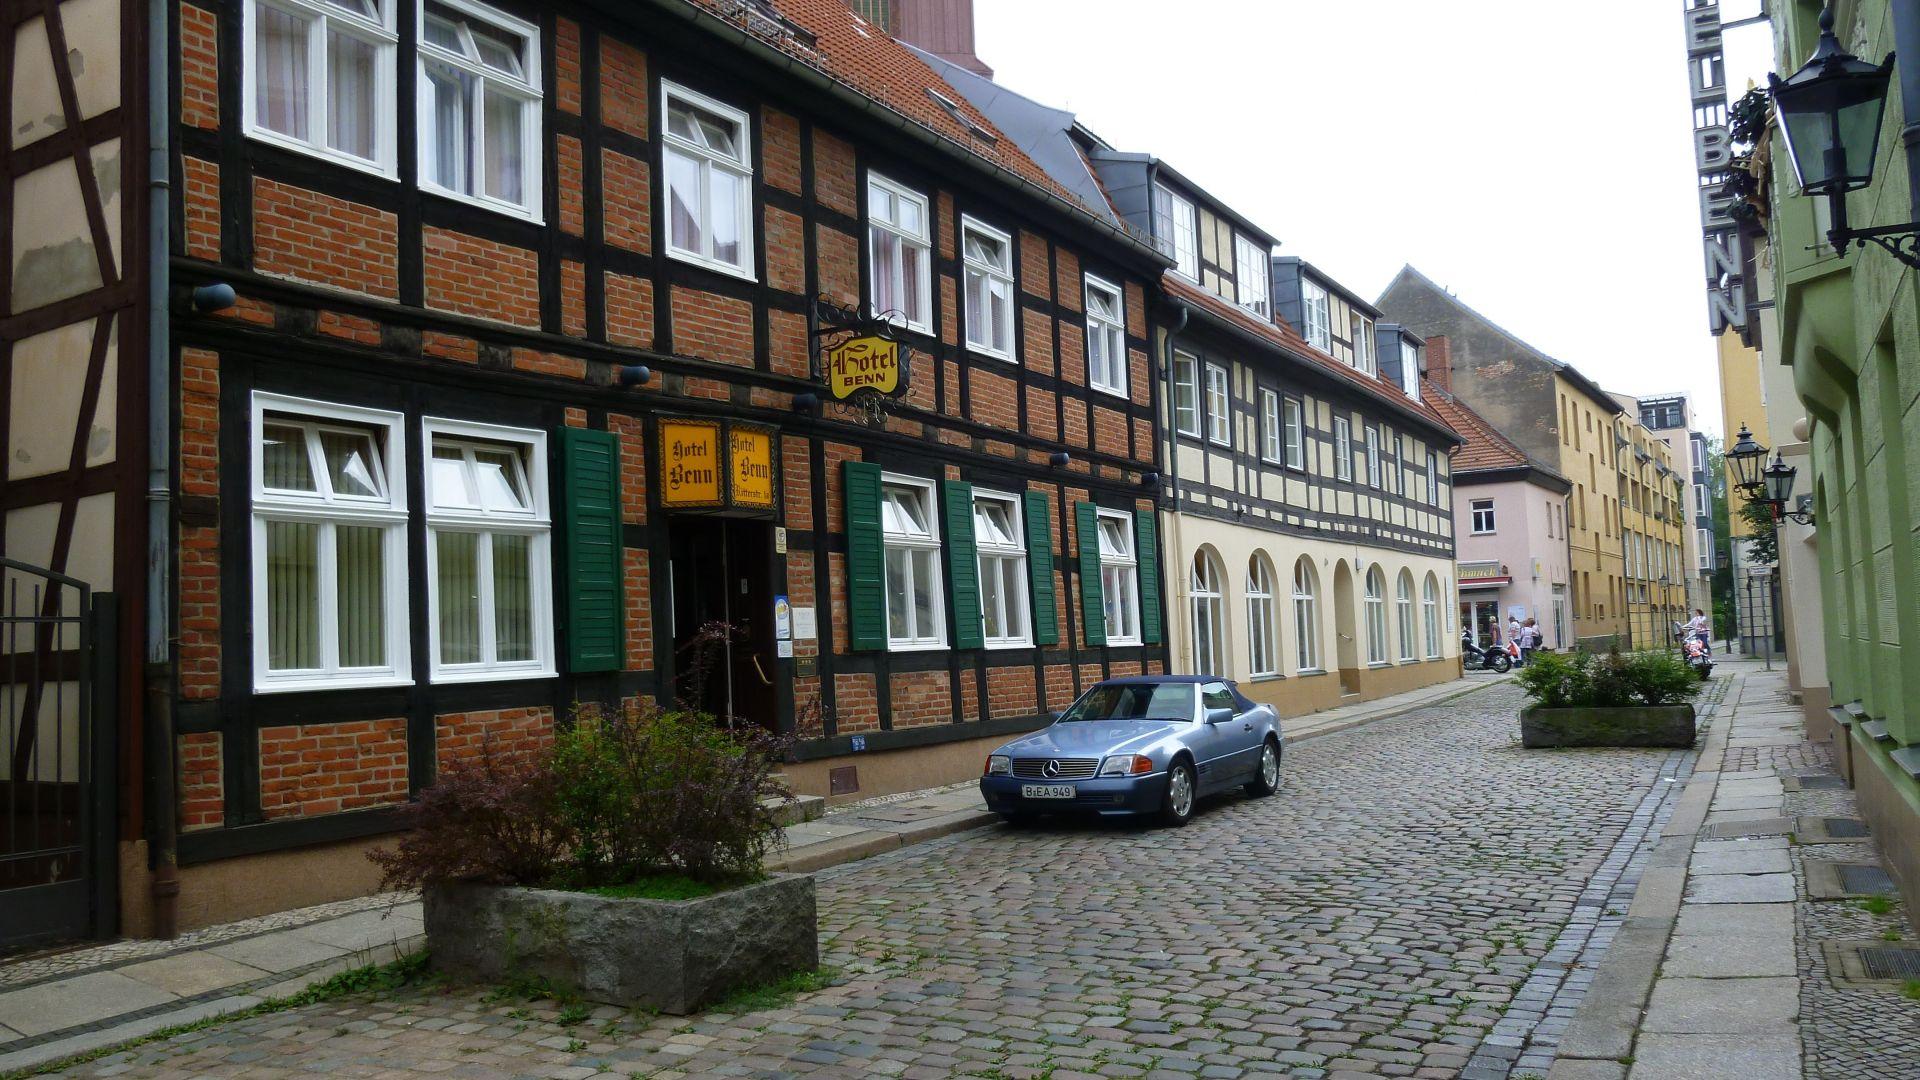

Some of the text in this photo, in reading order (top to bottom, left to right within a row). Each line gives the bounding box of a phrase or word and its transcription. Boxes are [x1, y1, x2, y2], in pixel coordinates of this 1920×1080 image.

[1683, 0, 1747, 335] EL BENN
[832, 344, 896, 375] Hotel
[843, 372, 886, 387] BENN
[672, 440, 707, 461] Hotel
[731, 433, 755, 454] Hotel
[669, 463, 713, 490] Benn
[741, 456, 768, 482] Benn
[1052, 787, 1070, 797] 949
